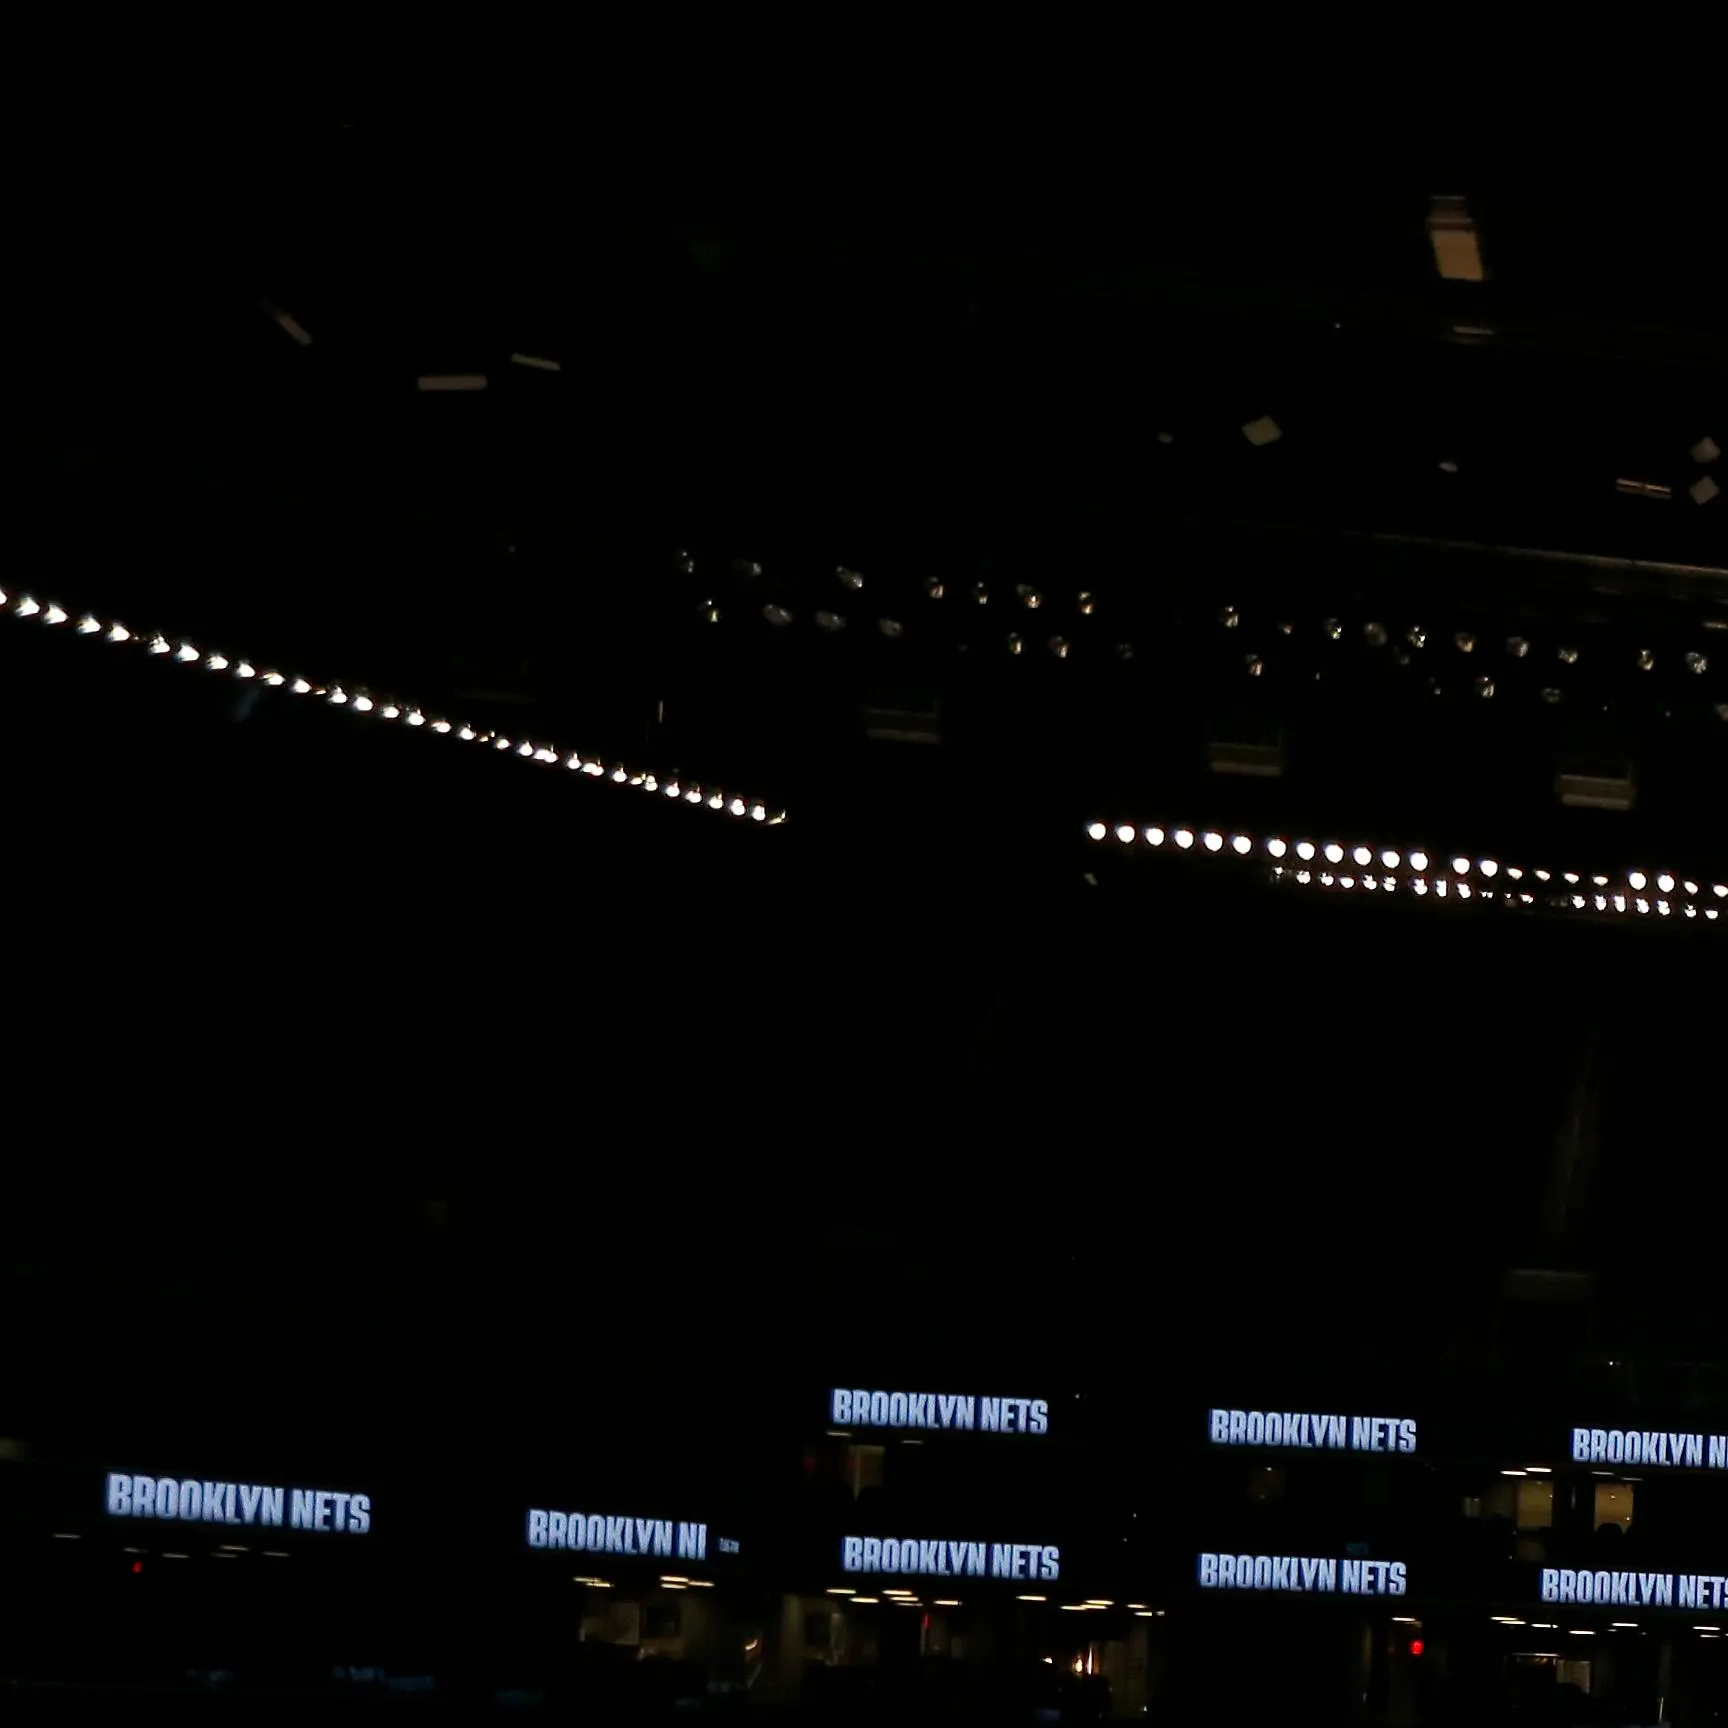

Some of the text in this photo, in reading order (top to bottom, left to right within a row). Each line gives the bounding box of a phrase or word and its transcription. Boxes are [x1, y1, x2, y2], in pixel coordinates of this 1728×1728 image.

[832, 1389, 1048, 1433] BROOKLYN NETS
[1211, 1409, 1416, 1452] BROOKLYN NETS
[1573, 1428, 1703, 1466] BROOKLYN
[107, 1474, 370, 1532] BROOKLYN NETS
[528, 1509, 672, 1555] BROOKLYN
[843, 1537, 1059, 1579] BROOKLYN NETS
[1199, 1553, 1406, 1594] BROOKLYN NETS
[1542, 1569, 1673, 1605] BROOKLYN
